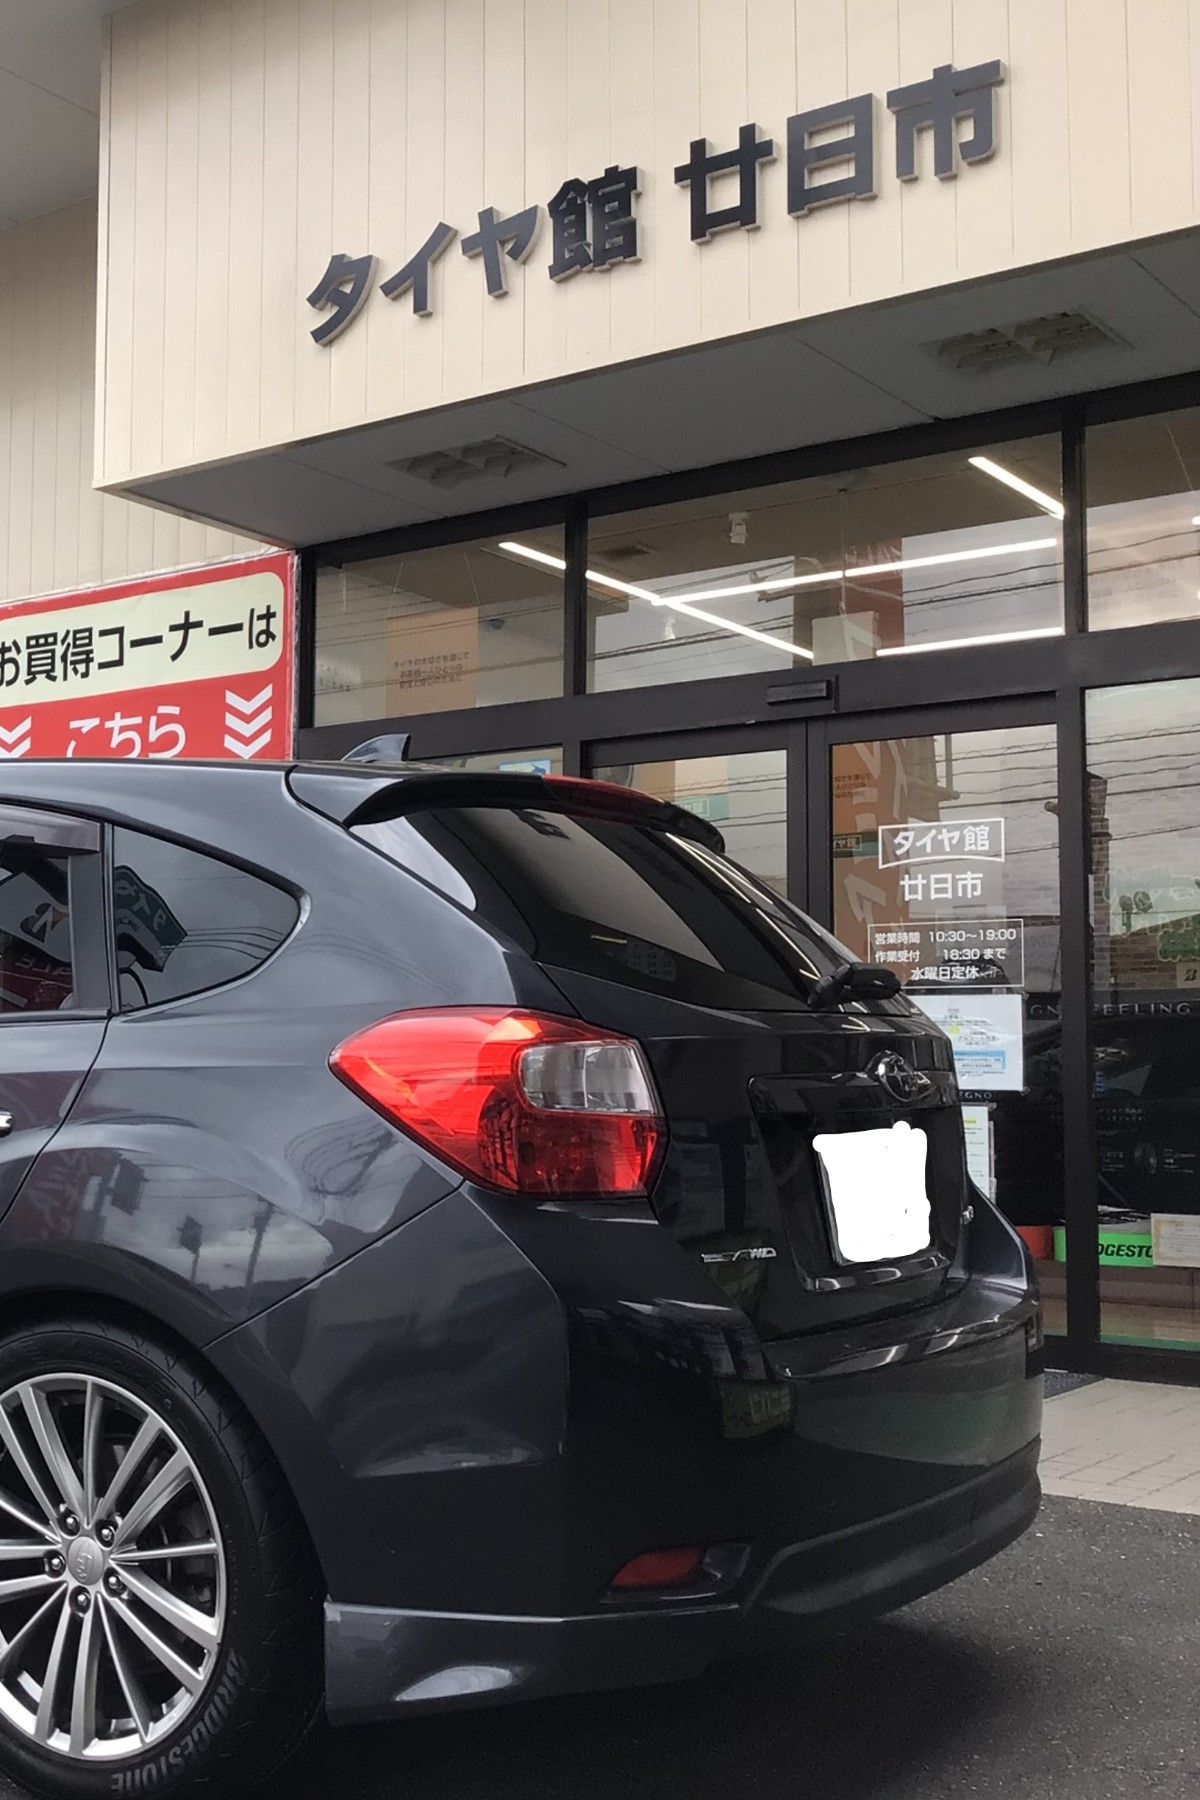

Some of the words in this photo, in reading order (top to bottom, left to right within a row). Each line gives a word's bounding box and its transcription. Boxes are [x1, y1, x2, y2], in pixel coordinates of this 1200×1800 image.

[306, 165, 641, 346] タイヤ館
[674, 59, 1005, 244] 廿日市
[64, 705, 187, 758] こちら
[894, 825, 990, 856] タイヤ館
[900, 871, 984, 902] 廿日市
[875, 931, 921, 945] 営業時間
[875, 950, 921, 964] 作業受付
[911, 966, 979, 981] 水曜日定休
[1097, 1243, 1154, 1258] DGESTO
